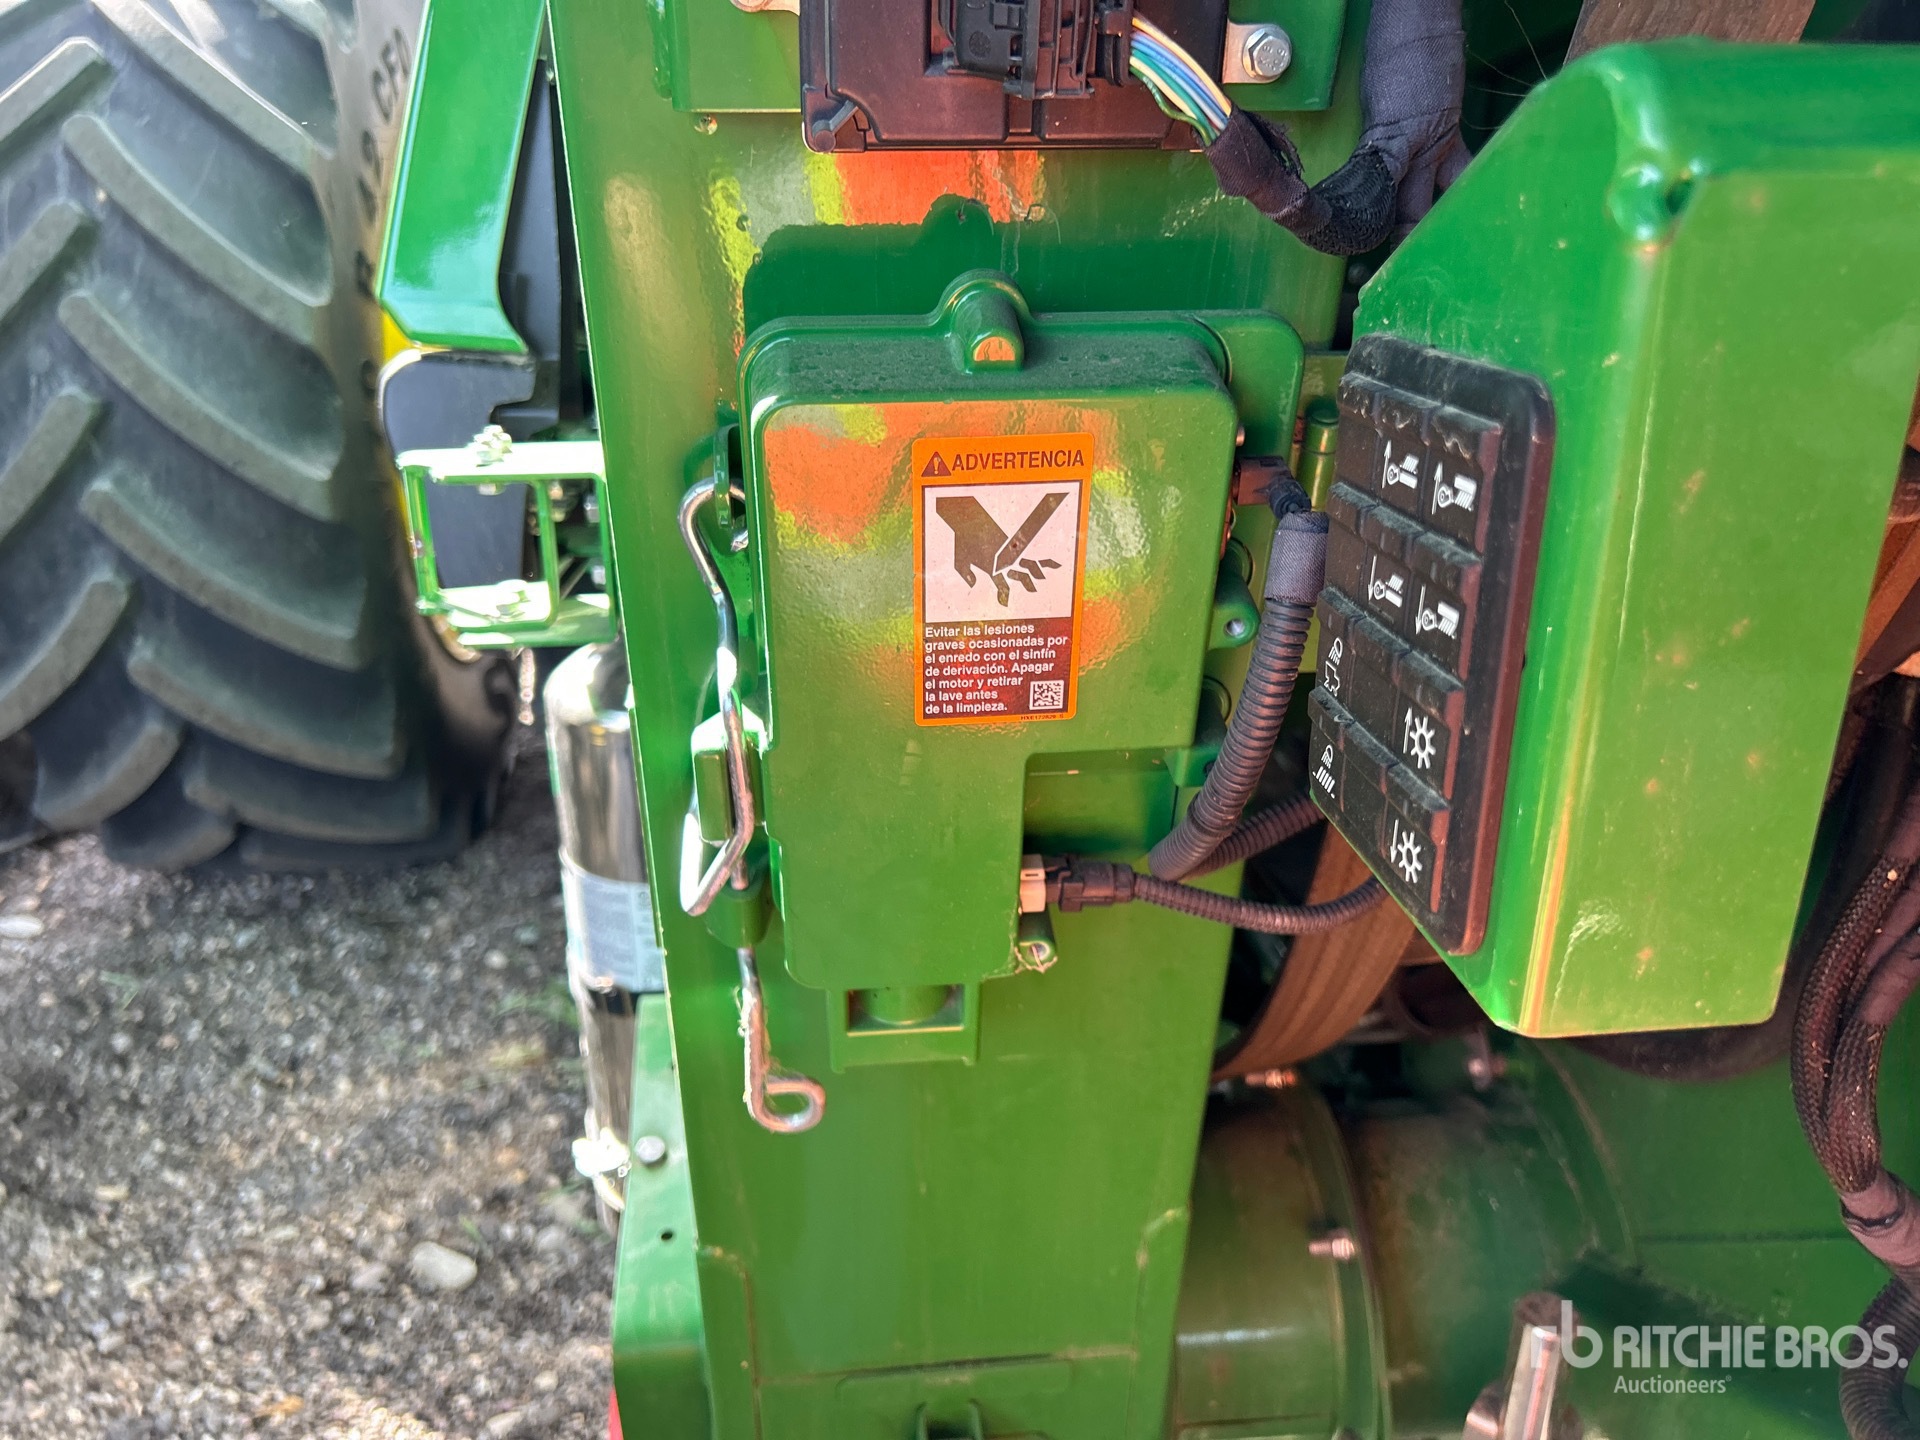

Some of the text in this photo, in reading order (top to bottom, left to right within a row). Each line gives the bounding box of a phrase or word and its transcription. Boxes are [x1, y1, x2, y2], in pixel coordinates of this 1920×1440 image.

[952, 449, 1084, 471] ADVERTENCIA
[925, 624, 1035, 638] Evitar las lesiones
[925, 636, 1068, 653] graves ocasionadas por
[925, 648, 1056, 664] el enredo con el sinfín
[925, 662, 1055, 677] de derivación. Apagar
[925, 675, 1023, 690] el motor y retirar
[925, 689, 998, 702] la lave antes
[925, 702, 1008, 715] de la limpieza.
